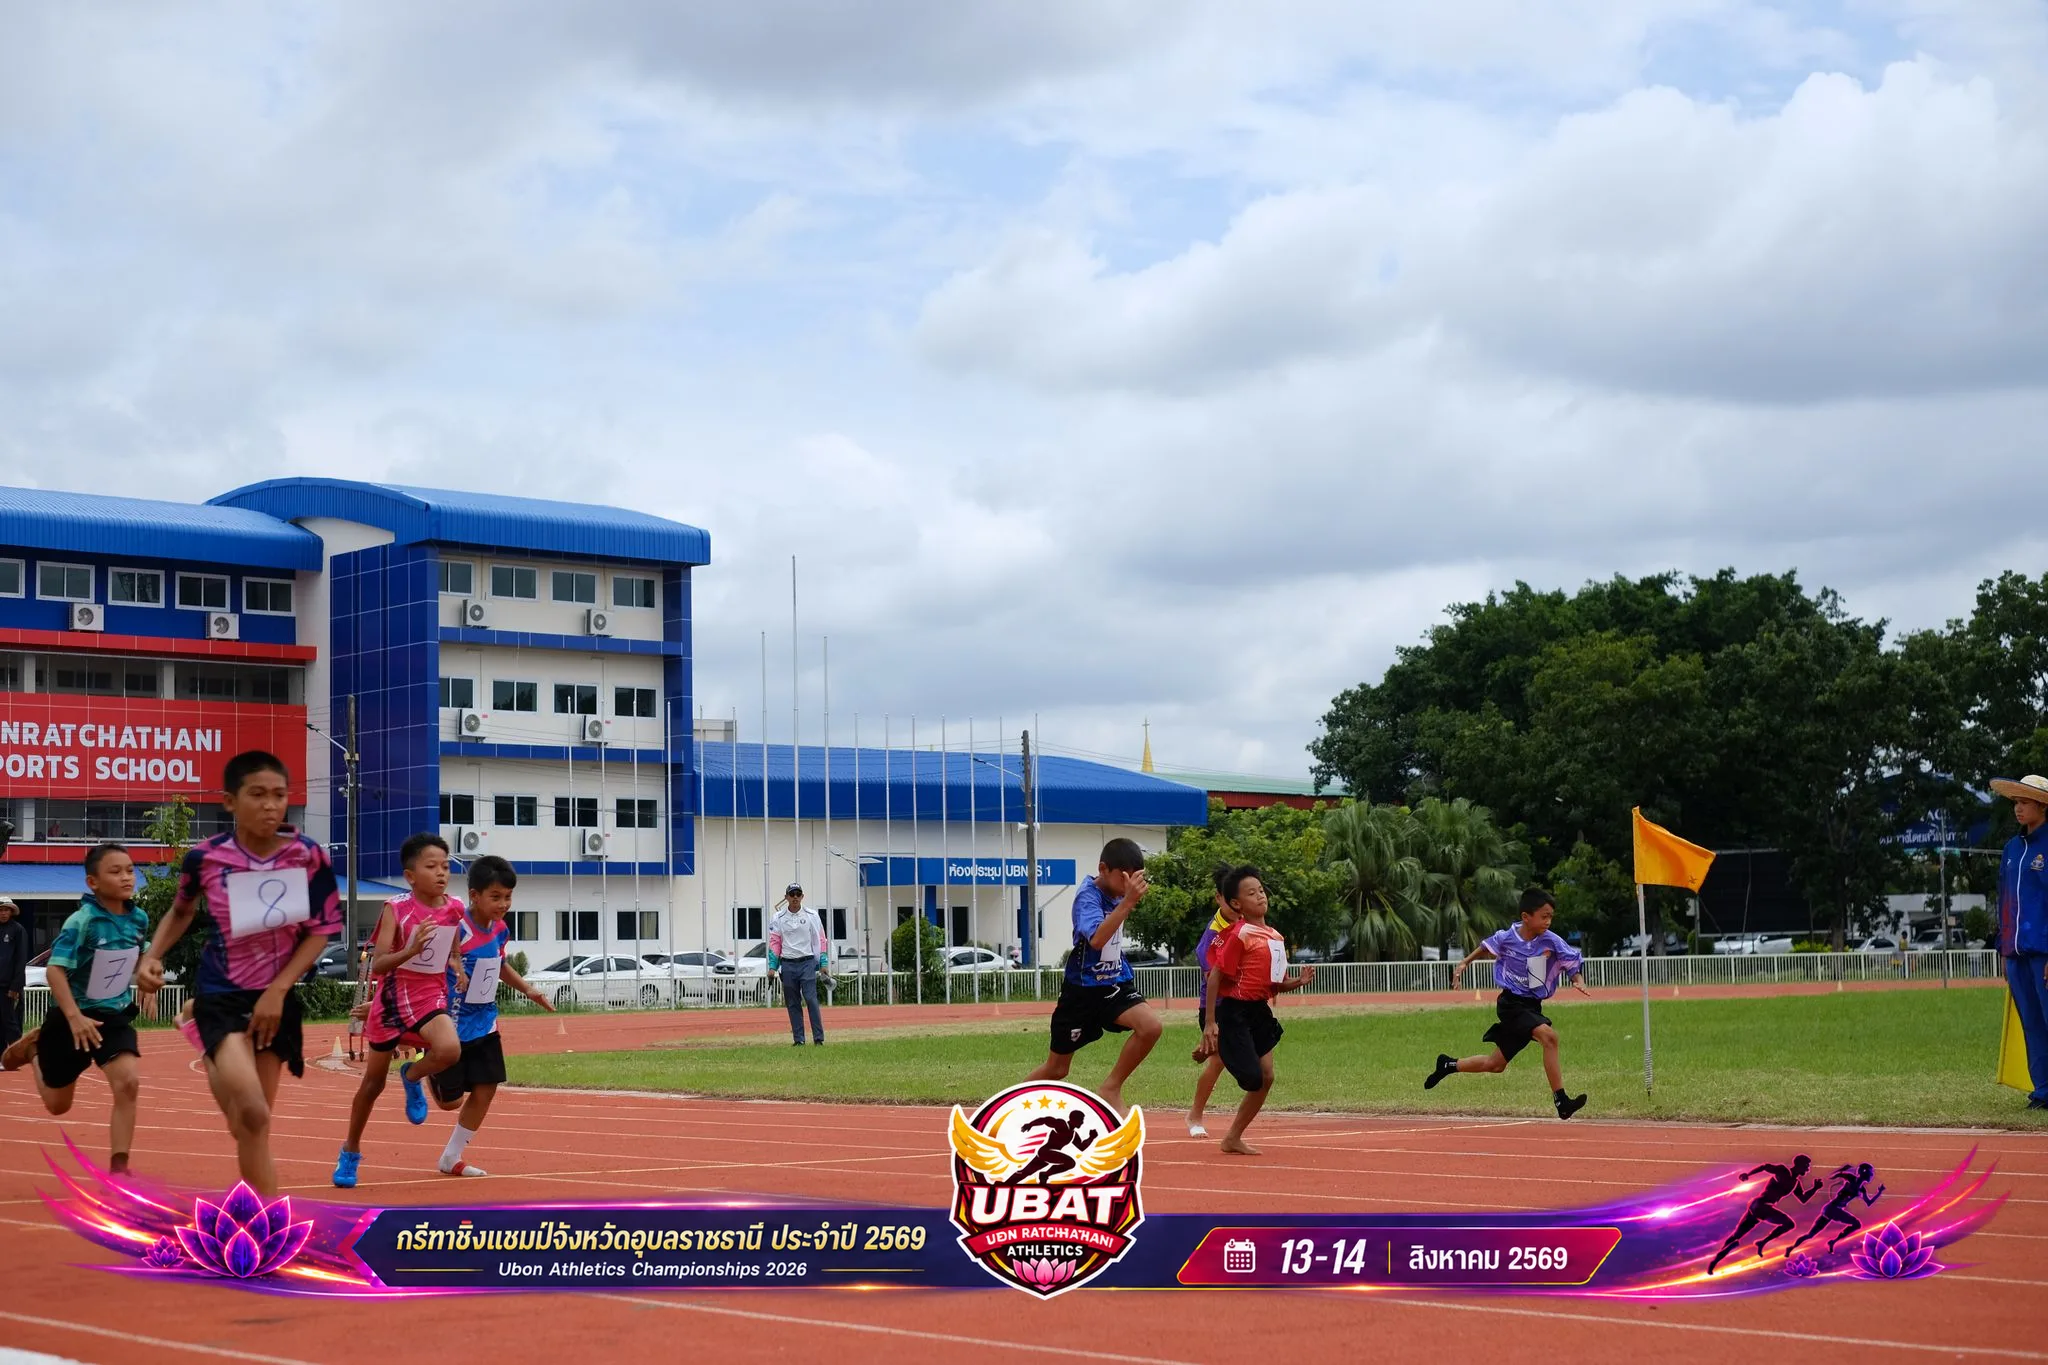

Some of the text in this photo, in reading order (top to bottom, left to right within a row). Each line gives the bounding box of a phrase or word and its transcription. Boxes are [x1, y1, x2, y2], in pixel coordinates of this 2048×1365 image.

[0, 754, 201, 783] ORTS SCHOOL
[949, 864, 1051, 880] ห้องประชุม UBNS 1
[258, 879, 287, 929] 8
[419, 933, 437, 962] 6
[104, 957, 127, 989] 7
[480, 968, 496, 996] 5
